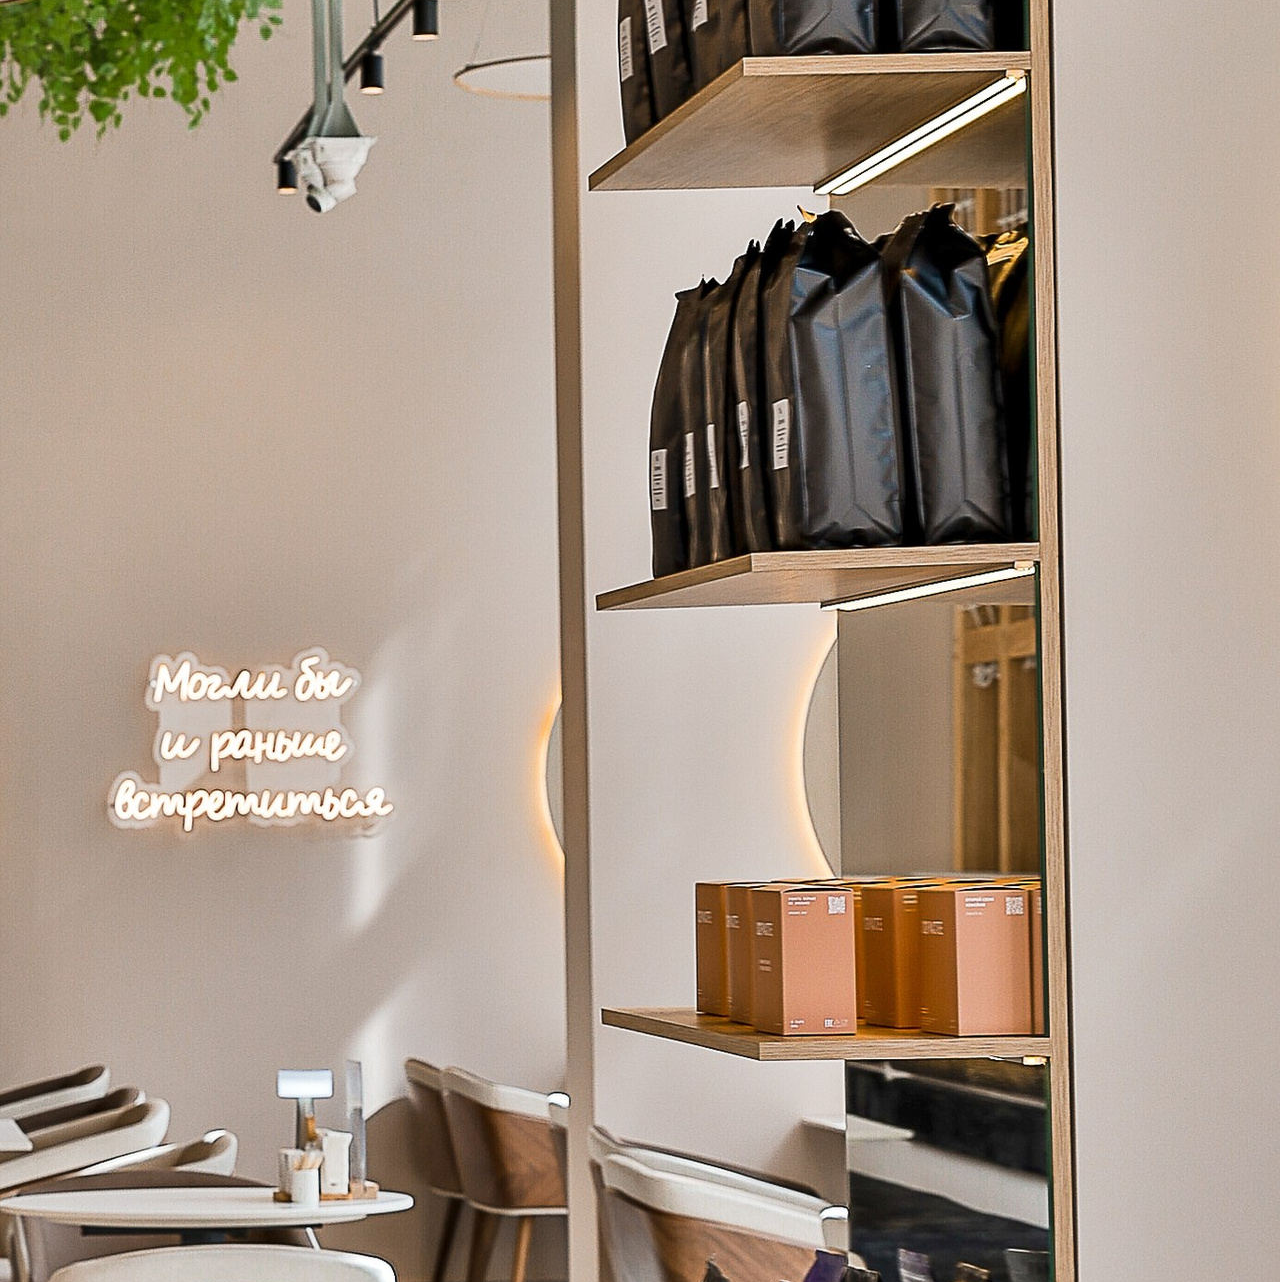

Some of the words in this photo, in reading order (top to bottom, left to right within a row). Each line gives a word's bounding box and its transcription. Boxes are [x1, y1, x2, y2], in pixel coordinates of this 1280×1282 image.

[154, 660, 287, 702] Могли
[295, 656, 354, 701] бы
[161, 731, 200, 760] и
[210, 729, 348, 771] раньше
[115, 779, 395, 832] встретиться
